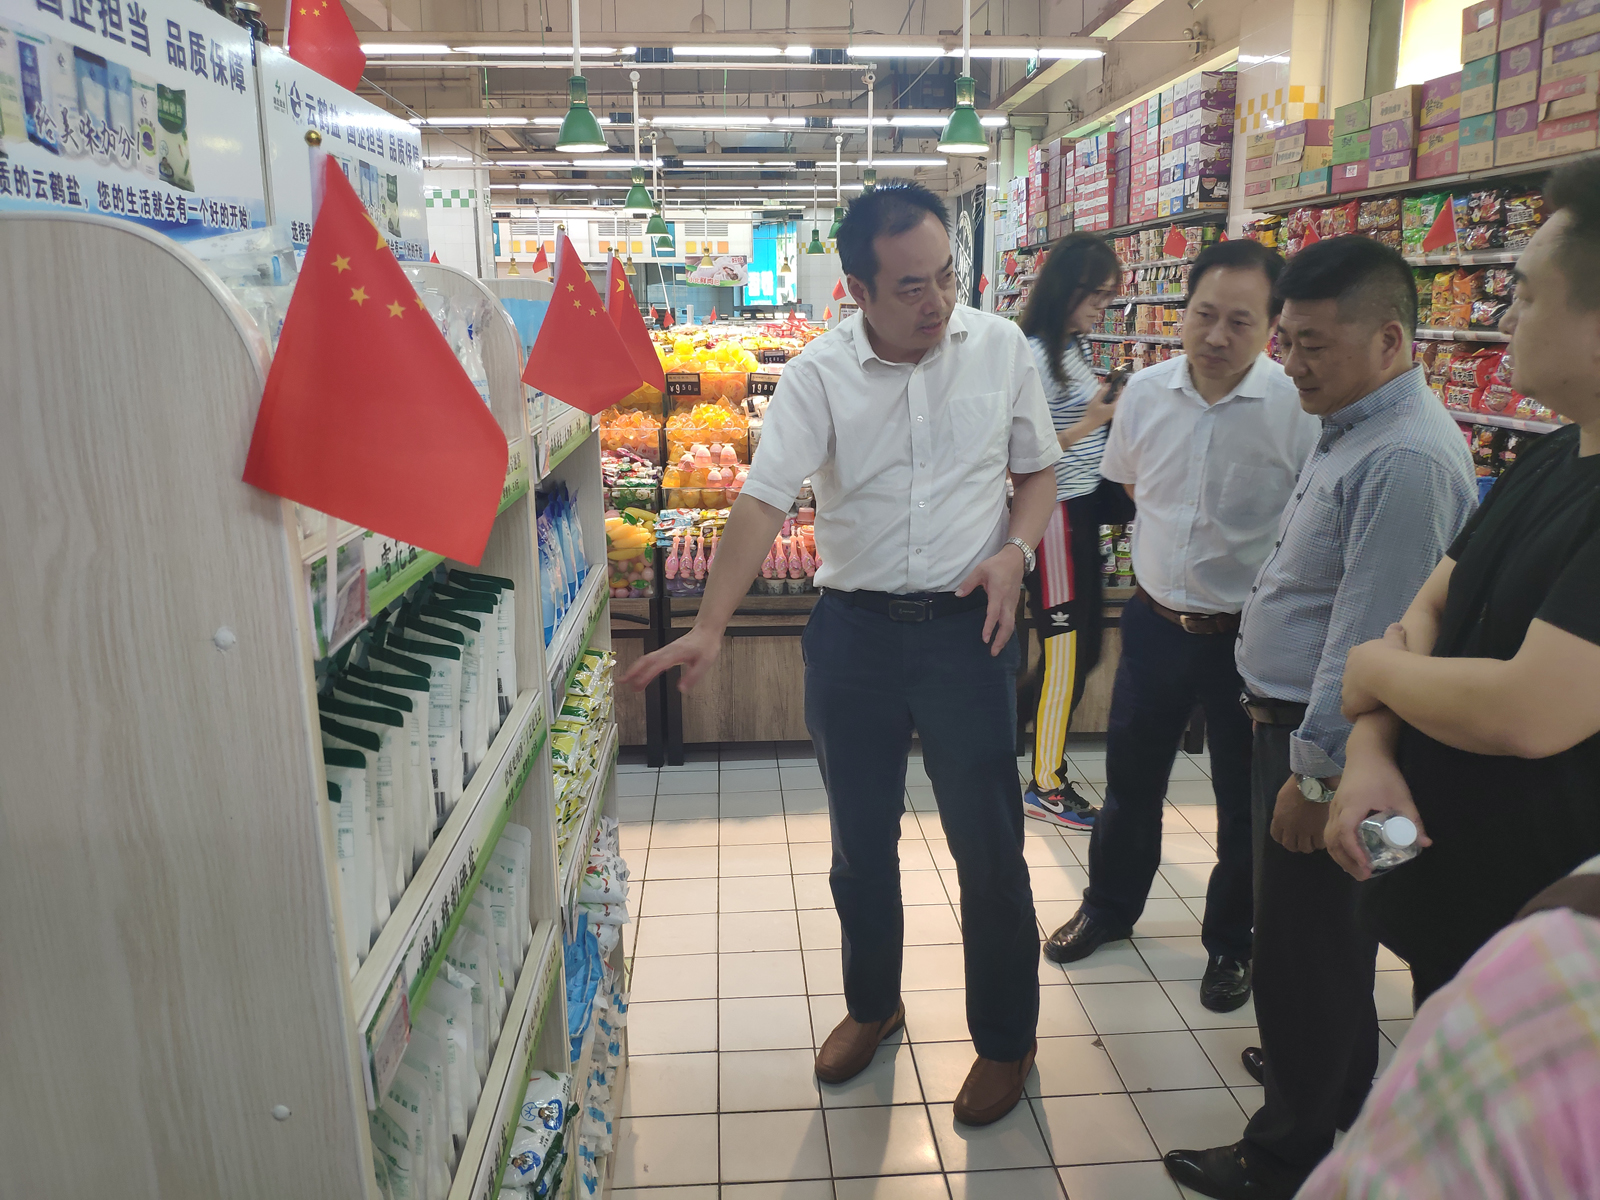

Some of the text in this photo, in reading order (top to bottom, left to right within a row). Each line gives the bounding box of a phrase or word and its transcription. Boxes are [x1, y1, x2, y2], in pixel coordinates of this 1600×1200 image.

[36, 0, 246, 94] 企担当 品质保障
[304, 92, 342, 139] 云鹤盐
[389, 133, 421, 171] 品质保障
